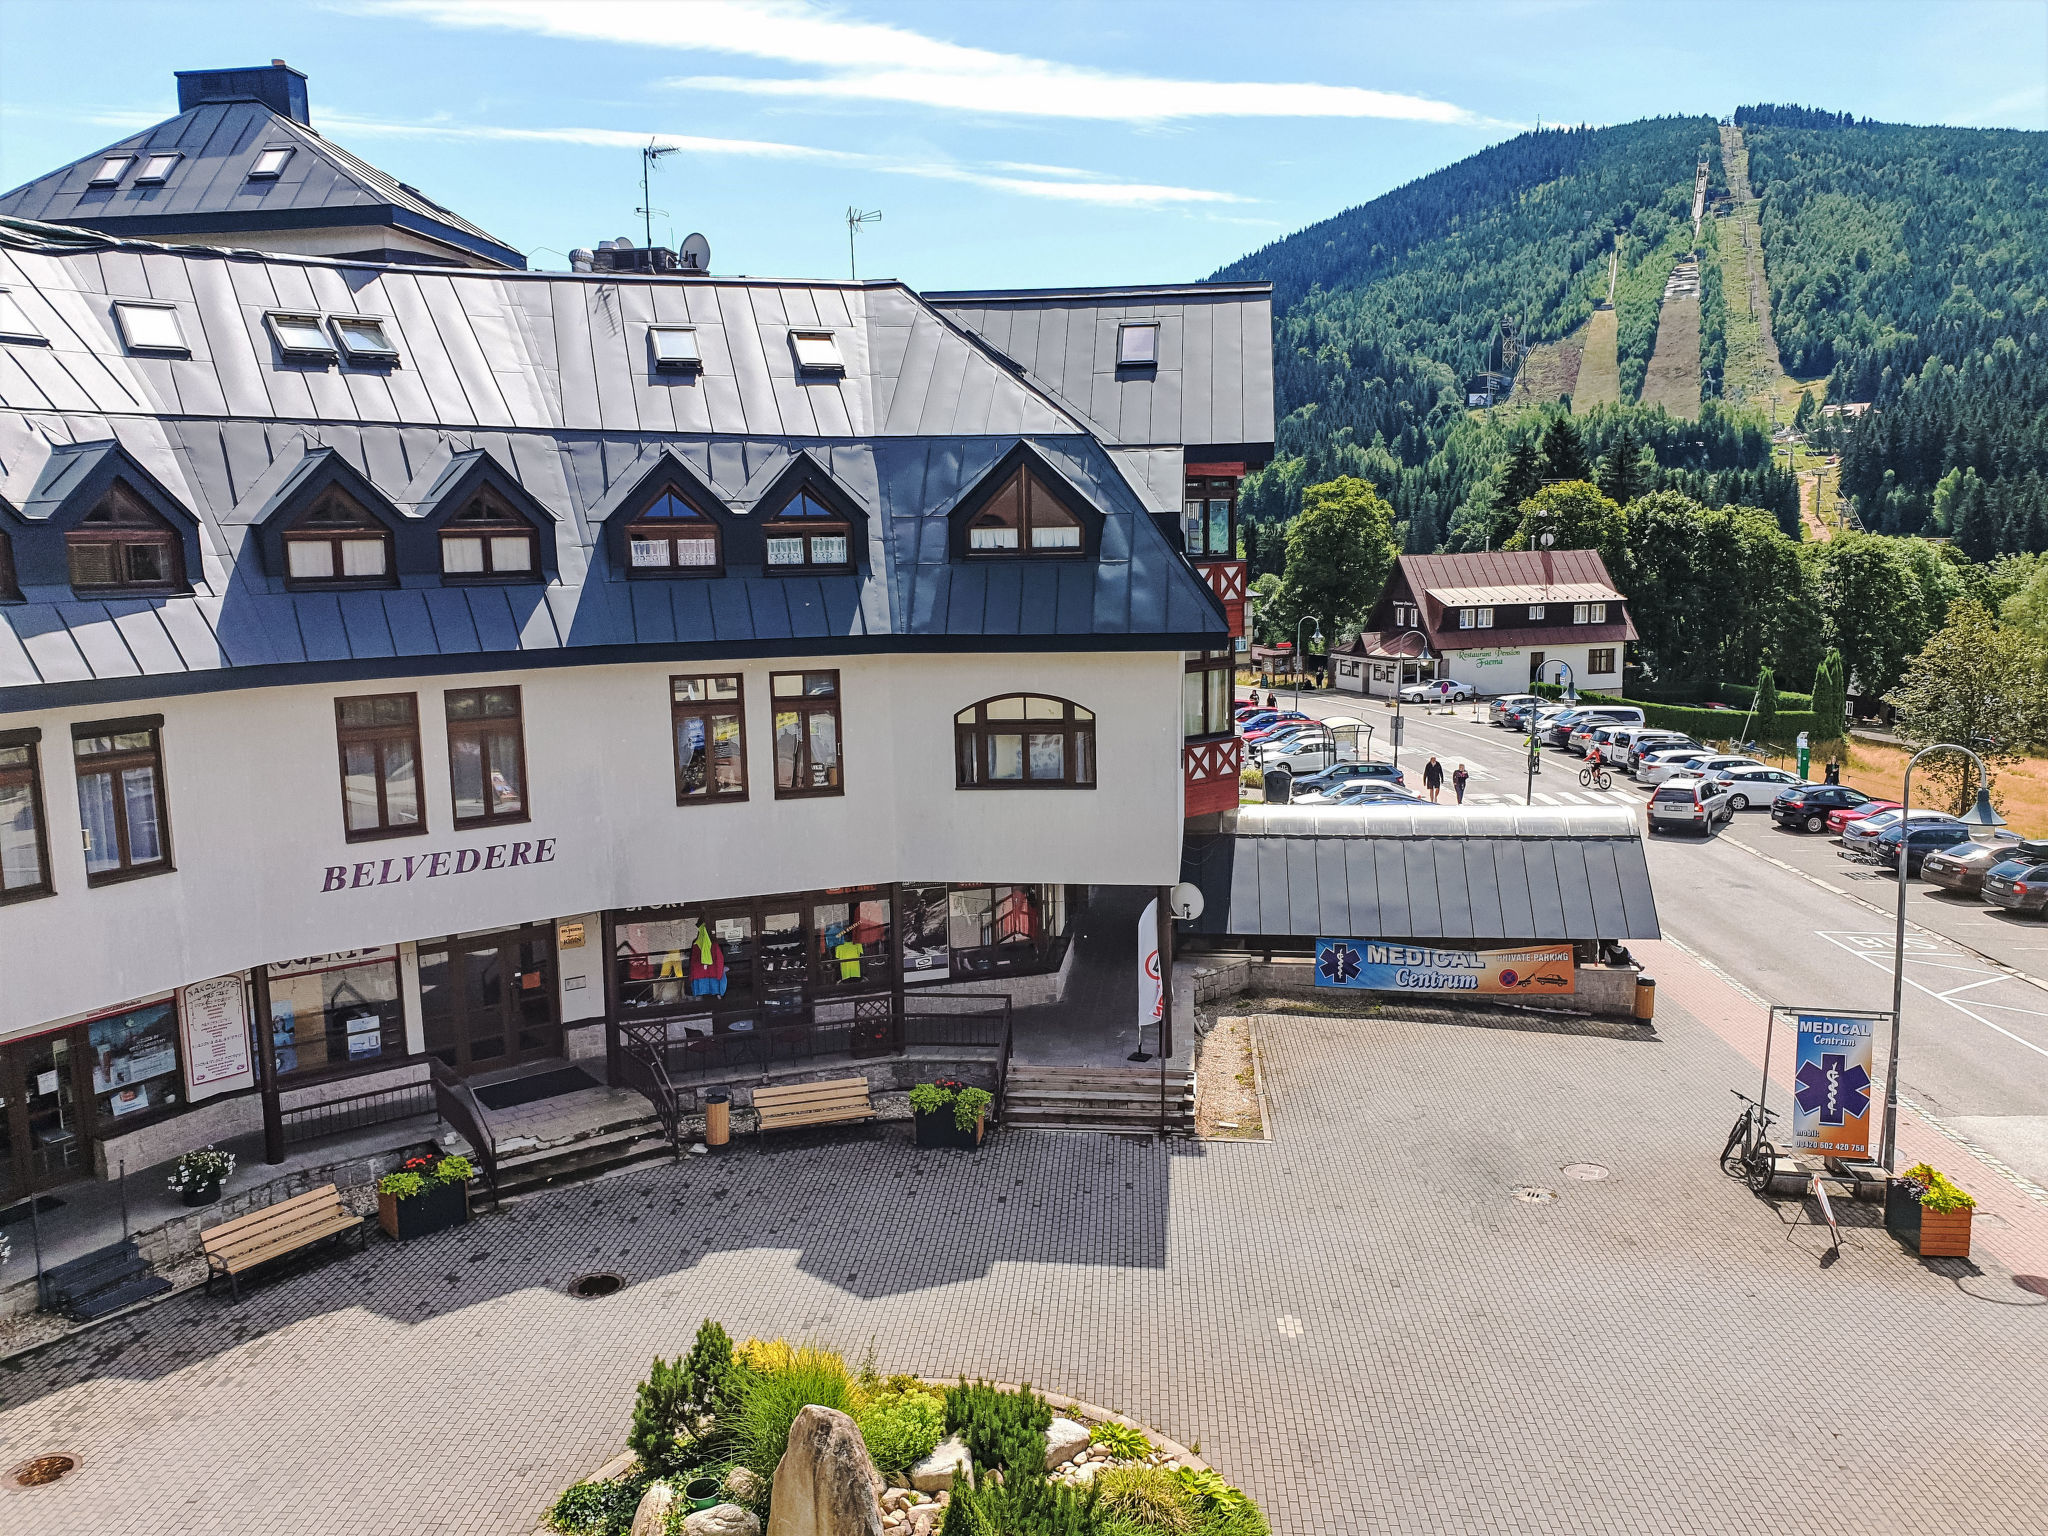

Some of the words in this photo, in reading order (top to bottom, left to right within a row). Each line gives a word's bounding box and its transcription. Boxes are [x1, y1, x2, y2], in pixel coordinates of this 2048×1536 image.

[320, 838, 557, 893] BELVEDERE
[1846, 936, 1938, 950] BUS
[1367, 944, 1485, 969] MEDICAL
[1395, 968, 1479, 989] Centrum
[1800, 1021, 1871, 1037] MEDICAL
[1813, 1034, 1856, 1047] Centrum
[1819, 1142, 1834, 1150] 602
[1835, 1143, 1849, 1151] 420
